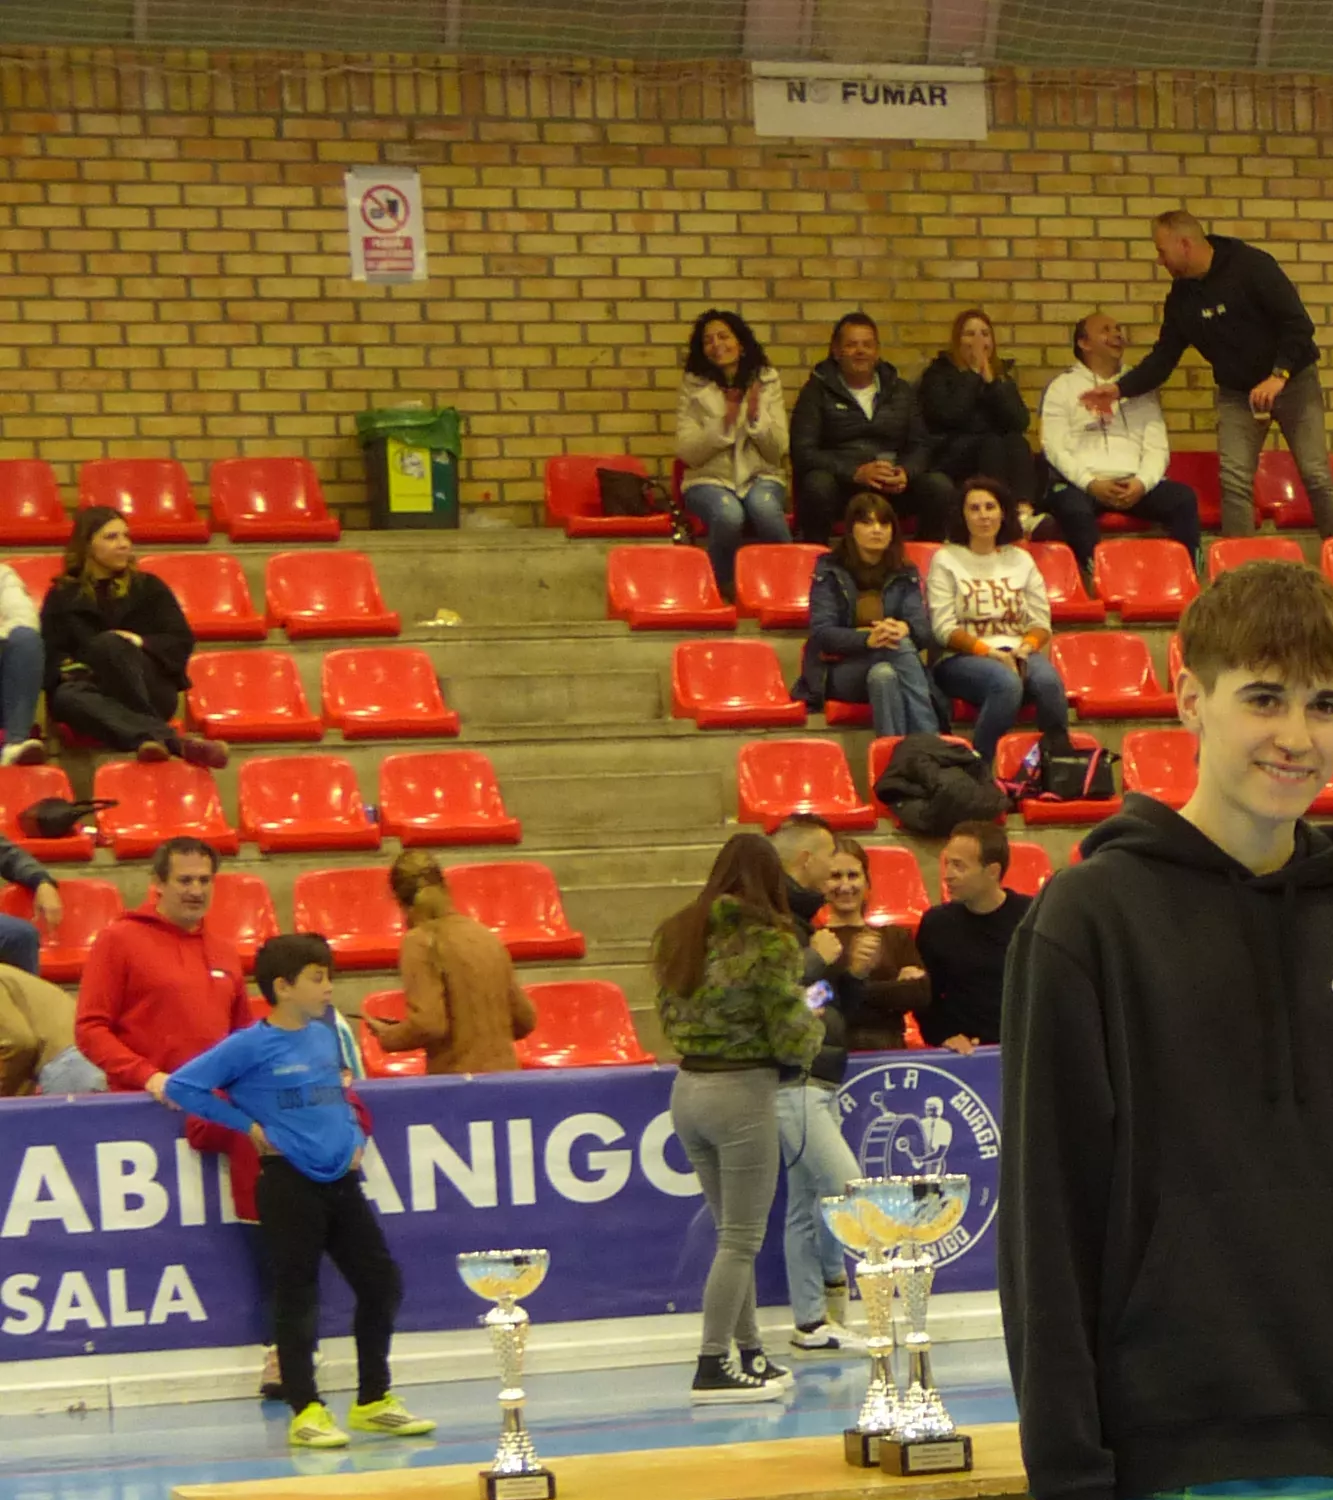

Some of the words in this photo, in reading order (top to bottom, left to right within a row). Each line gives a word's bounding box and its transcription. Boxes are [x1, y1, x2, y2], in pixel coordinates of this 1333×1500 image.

[841, 81, 948, 106] FUMAR
[884, 1069, 919, 1090] LA
[949, 1089, 999, 1161] MURGA
[0, 1264, 208, 1336] SALA
